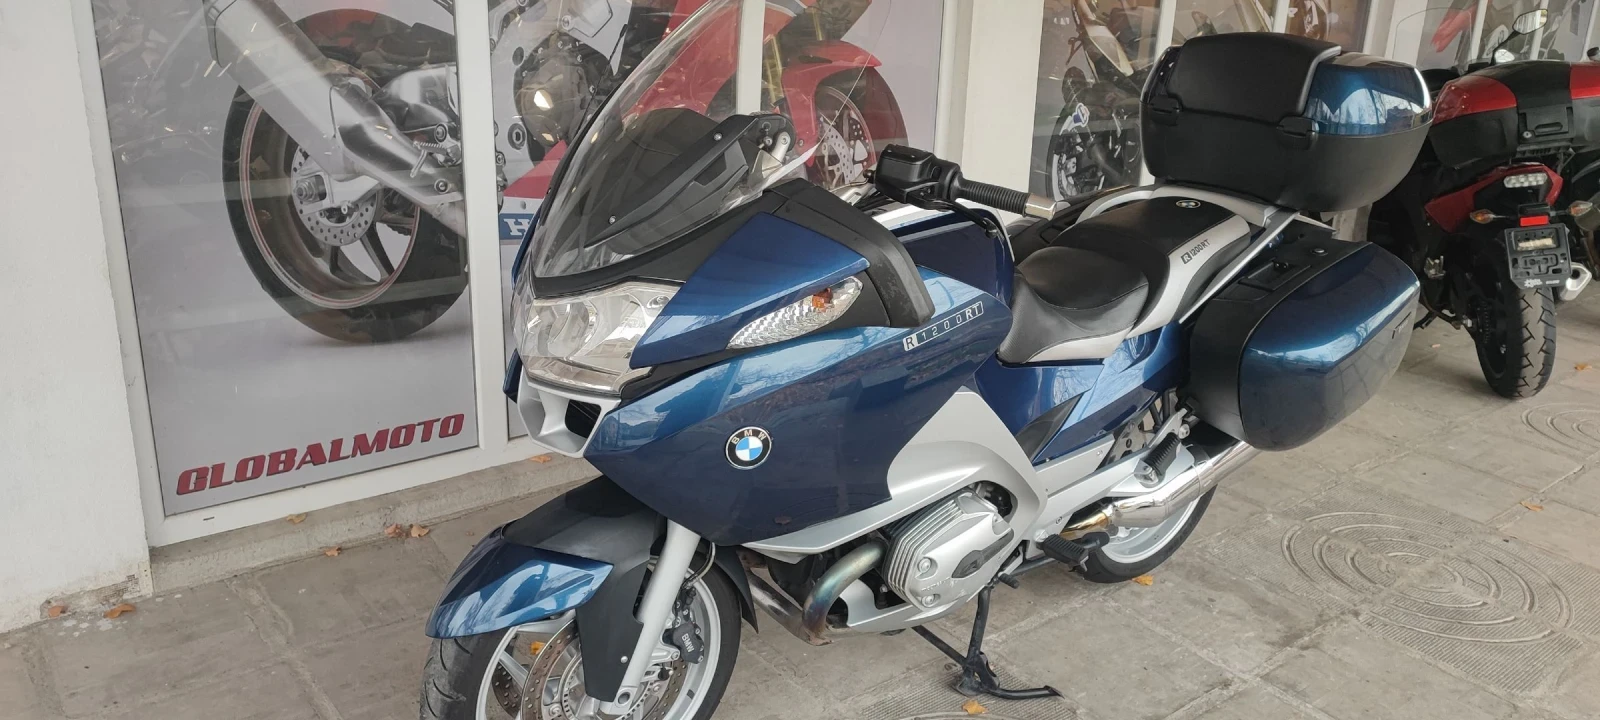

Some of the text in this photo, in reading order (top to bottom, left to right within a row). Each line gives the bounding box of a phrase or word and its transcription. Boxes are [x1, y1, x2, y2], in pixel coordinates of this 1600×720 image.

[1189, 239, 1211, 257] 1200RT
[904, 303, 981, 350] R 1200RT
[731, 429, 767, 445] BMW
[175, 413, 465, 496] GLOBALMOTO
[681, 633, 695, 653] BMW
